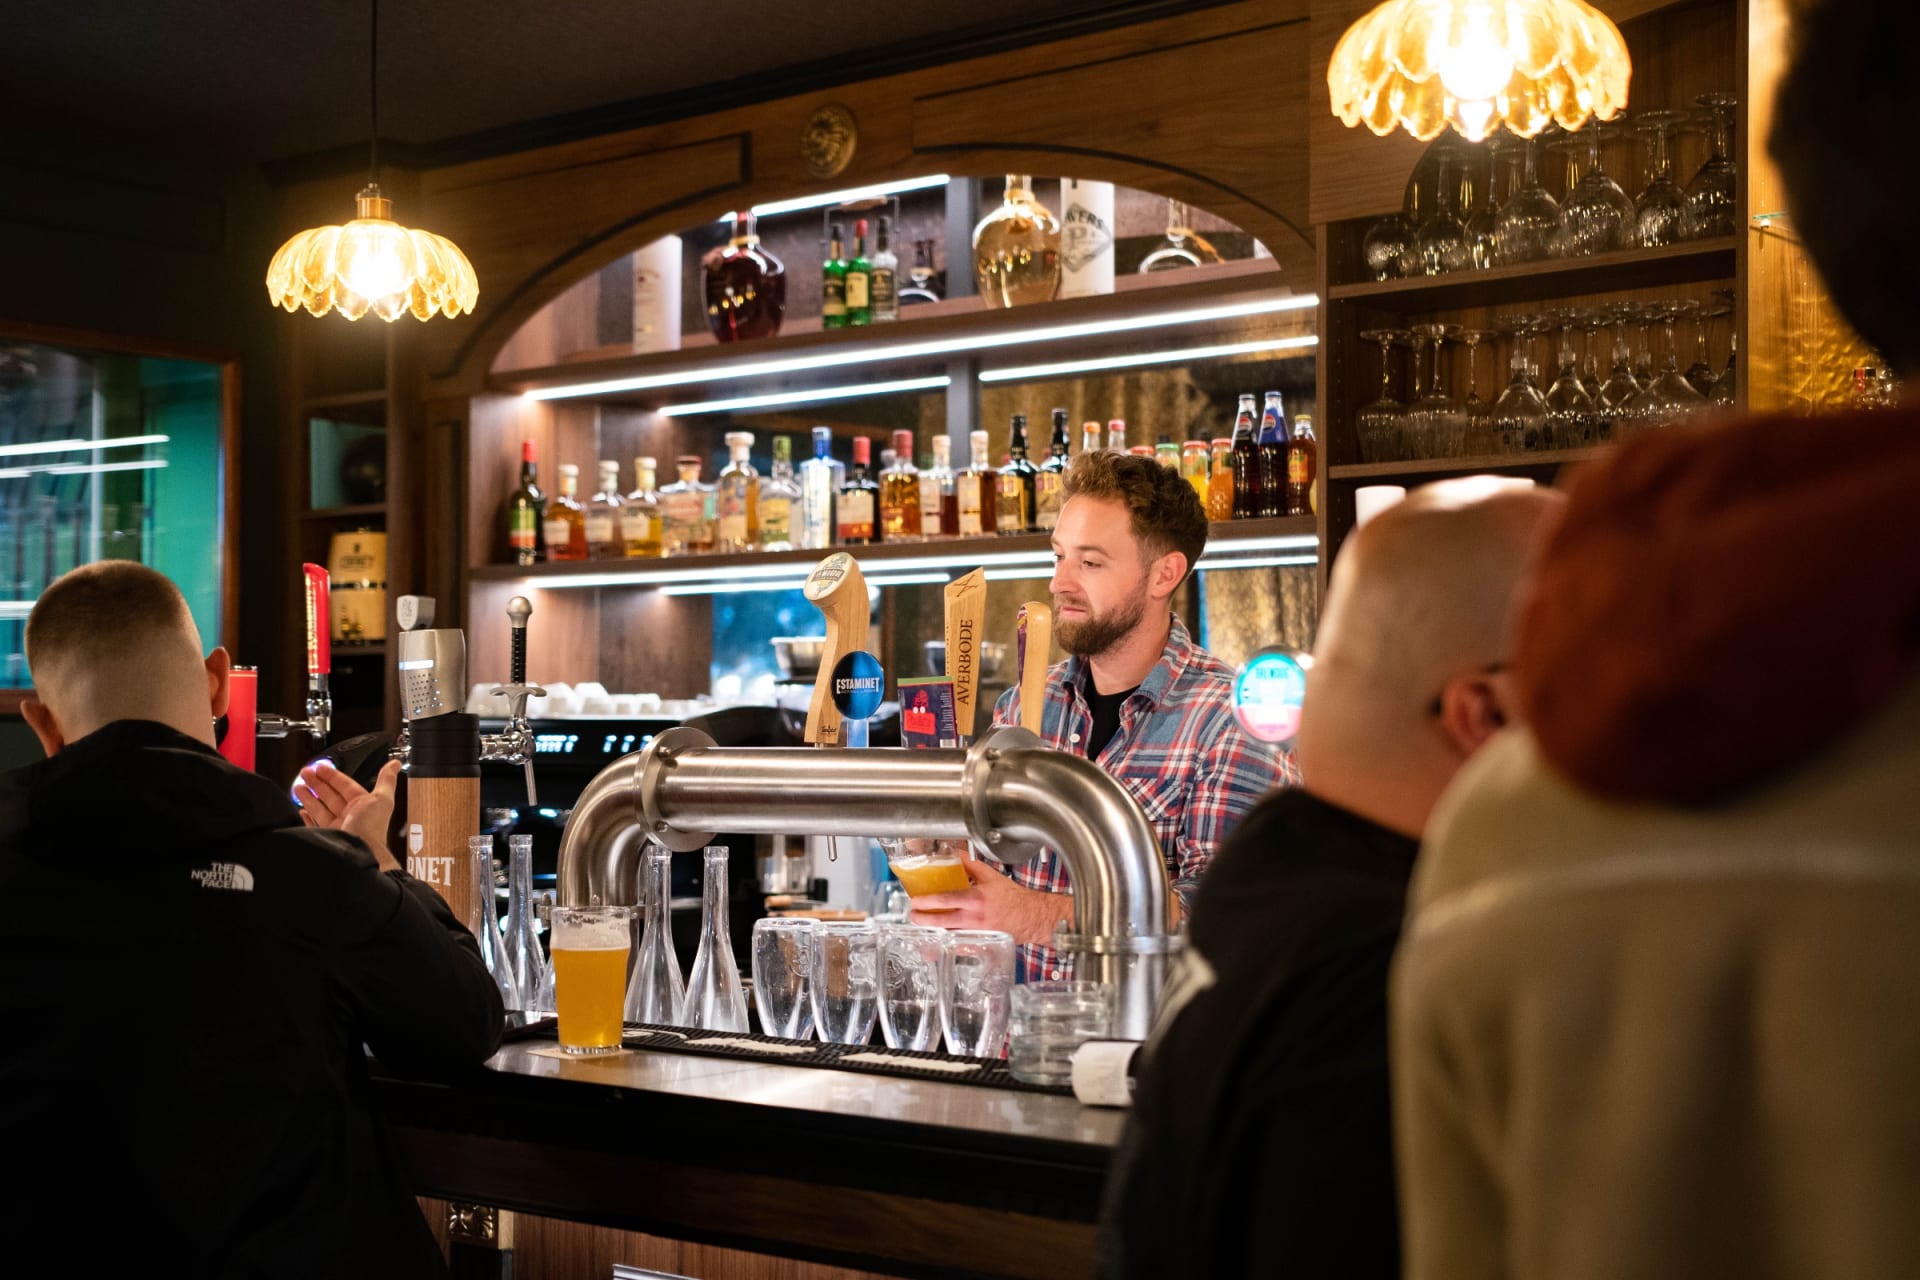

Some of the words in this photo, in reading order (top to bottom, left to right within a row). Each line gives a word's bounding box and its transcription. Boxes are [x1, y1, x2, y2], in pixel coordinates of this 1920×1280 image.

[957, 619, 973, 706] AVERBODE
[836, 677, 880, 694] ESTAMINET
[211, 862, 234, 873] THE
[191, 870, 233, 881] NORTH
[201, 880, 232, 889] FACE
